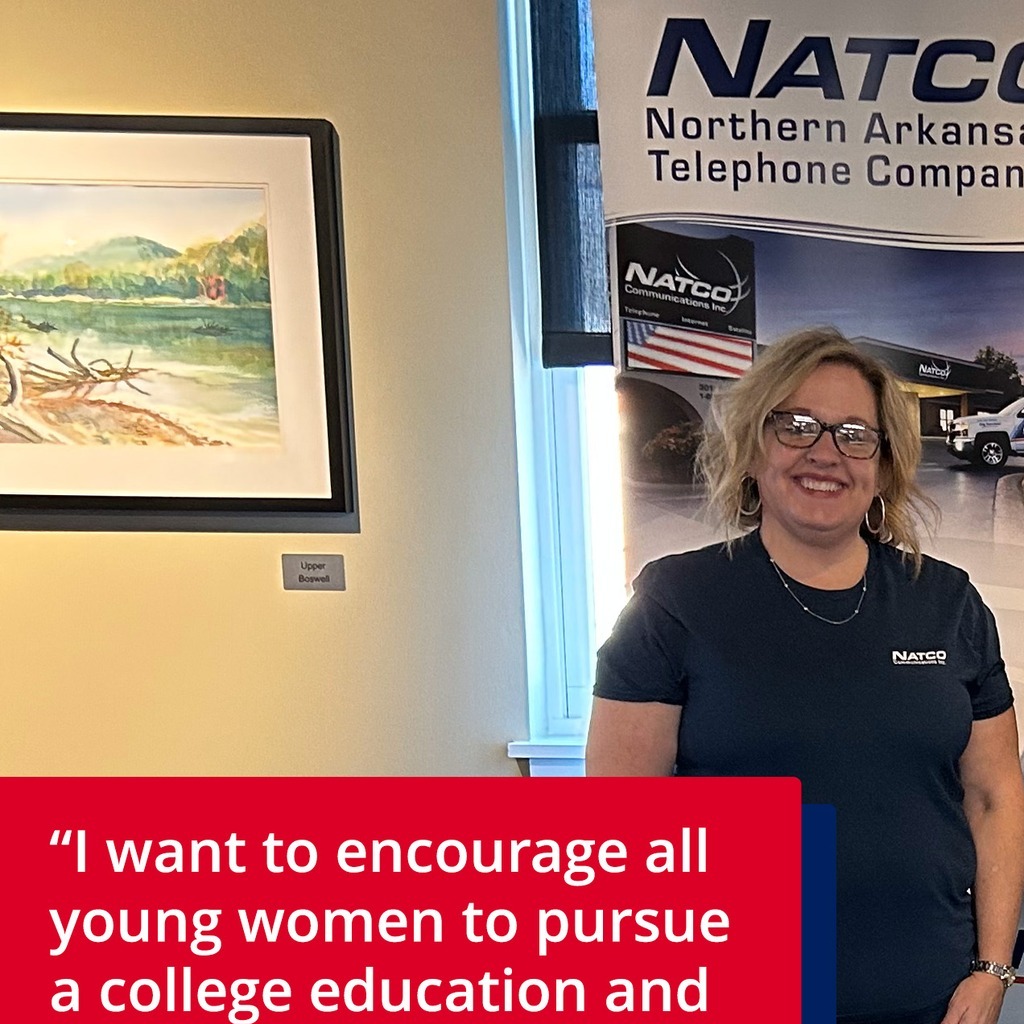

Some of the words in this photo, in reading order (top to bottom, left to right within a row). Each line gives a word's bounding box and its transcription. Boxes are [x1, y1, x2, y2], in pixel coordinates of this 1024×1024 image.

[646, 107, 847, 144] Northern
[647, 149, 852, 192] Telephone
[625, 262, 732, 303] NATCO
[300, 561, 327, 571] Upper
[298, 574, 331, 583] Boswell
[892, 650, 947, 661] NATCO
